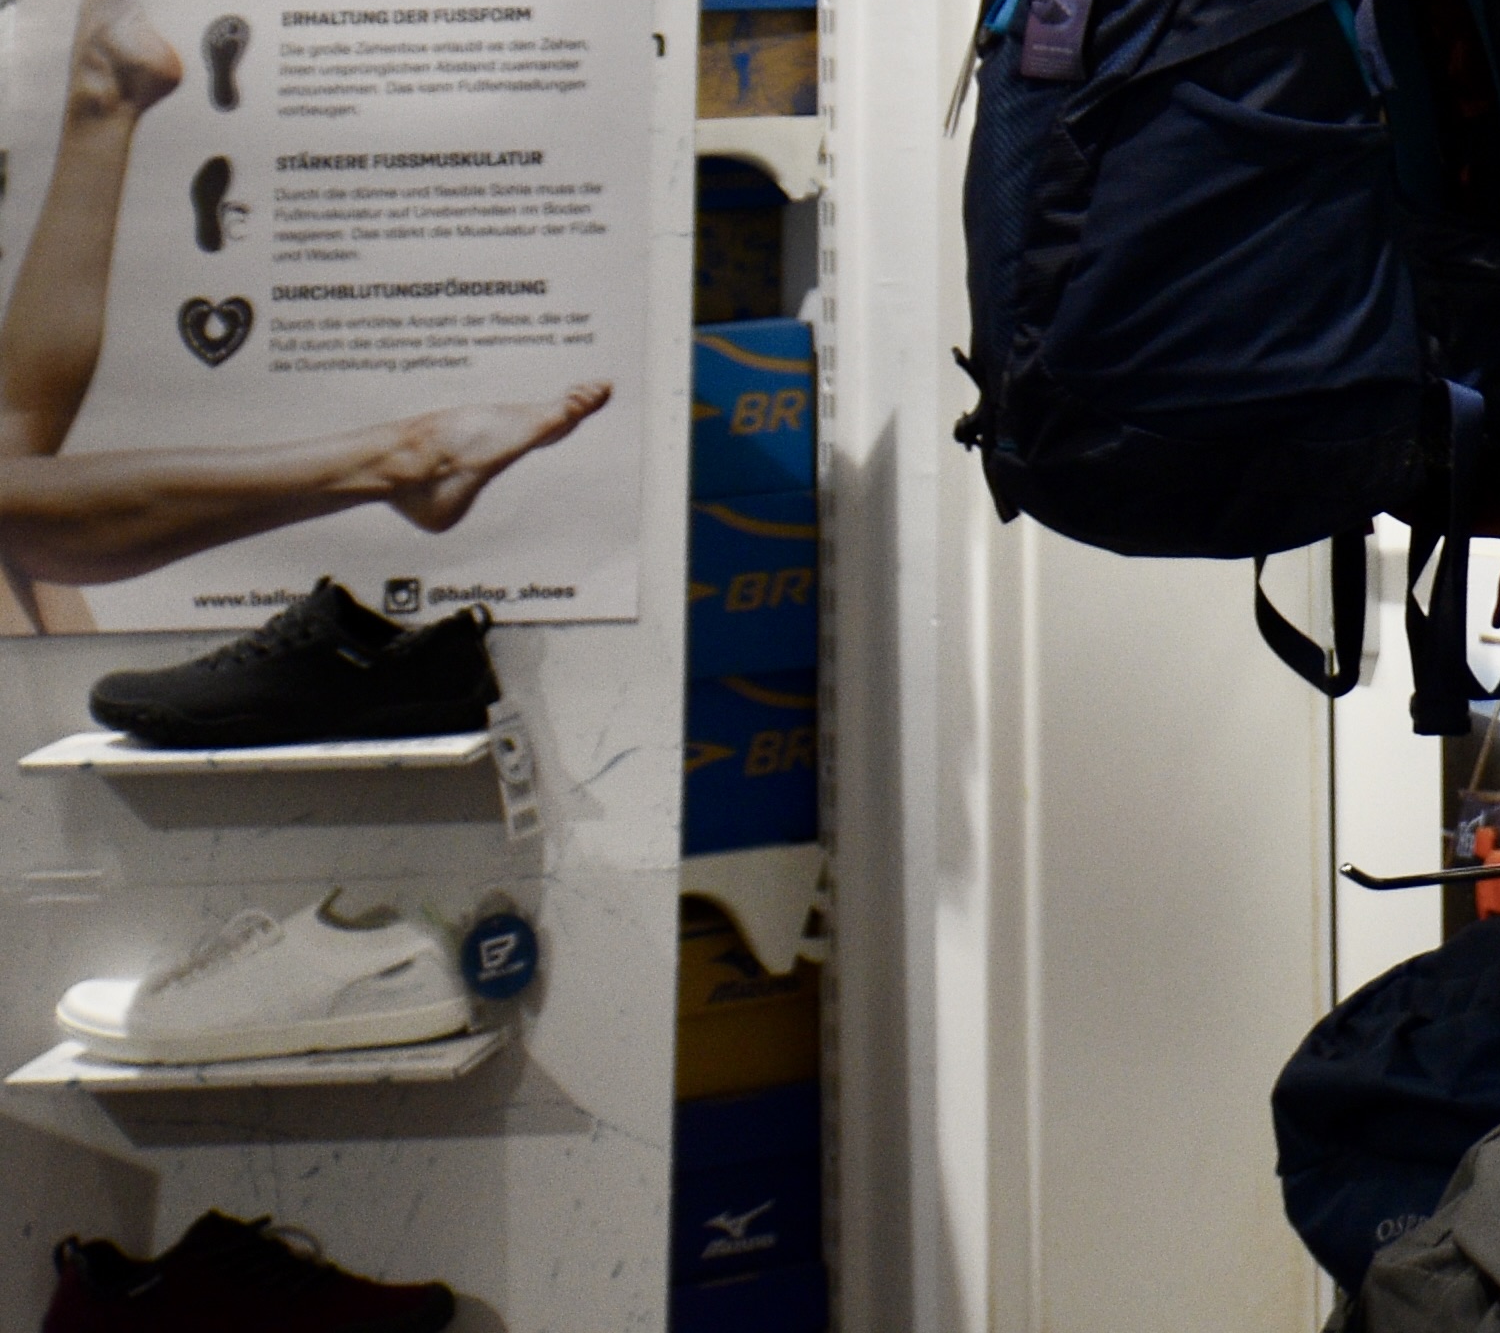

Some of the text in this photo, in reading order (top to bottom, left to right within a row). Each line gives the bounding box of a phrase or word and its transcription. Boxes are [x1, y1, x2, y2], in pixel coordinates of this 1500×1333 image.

[282, 7, 532, 27] ERHALTUNG DER FUSSFORM
[276, 150, 545, 171] STÄRKERE FUSSMUSKULATUR
[271, 279, 547, 301] DURCHBLUTUNGSFÖRDERUNG
